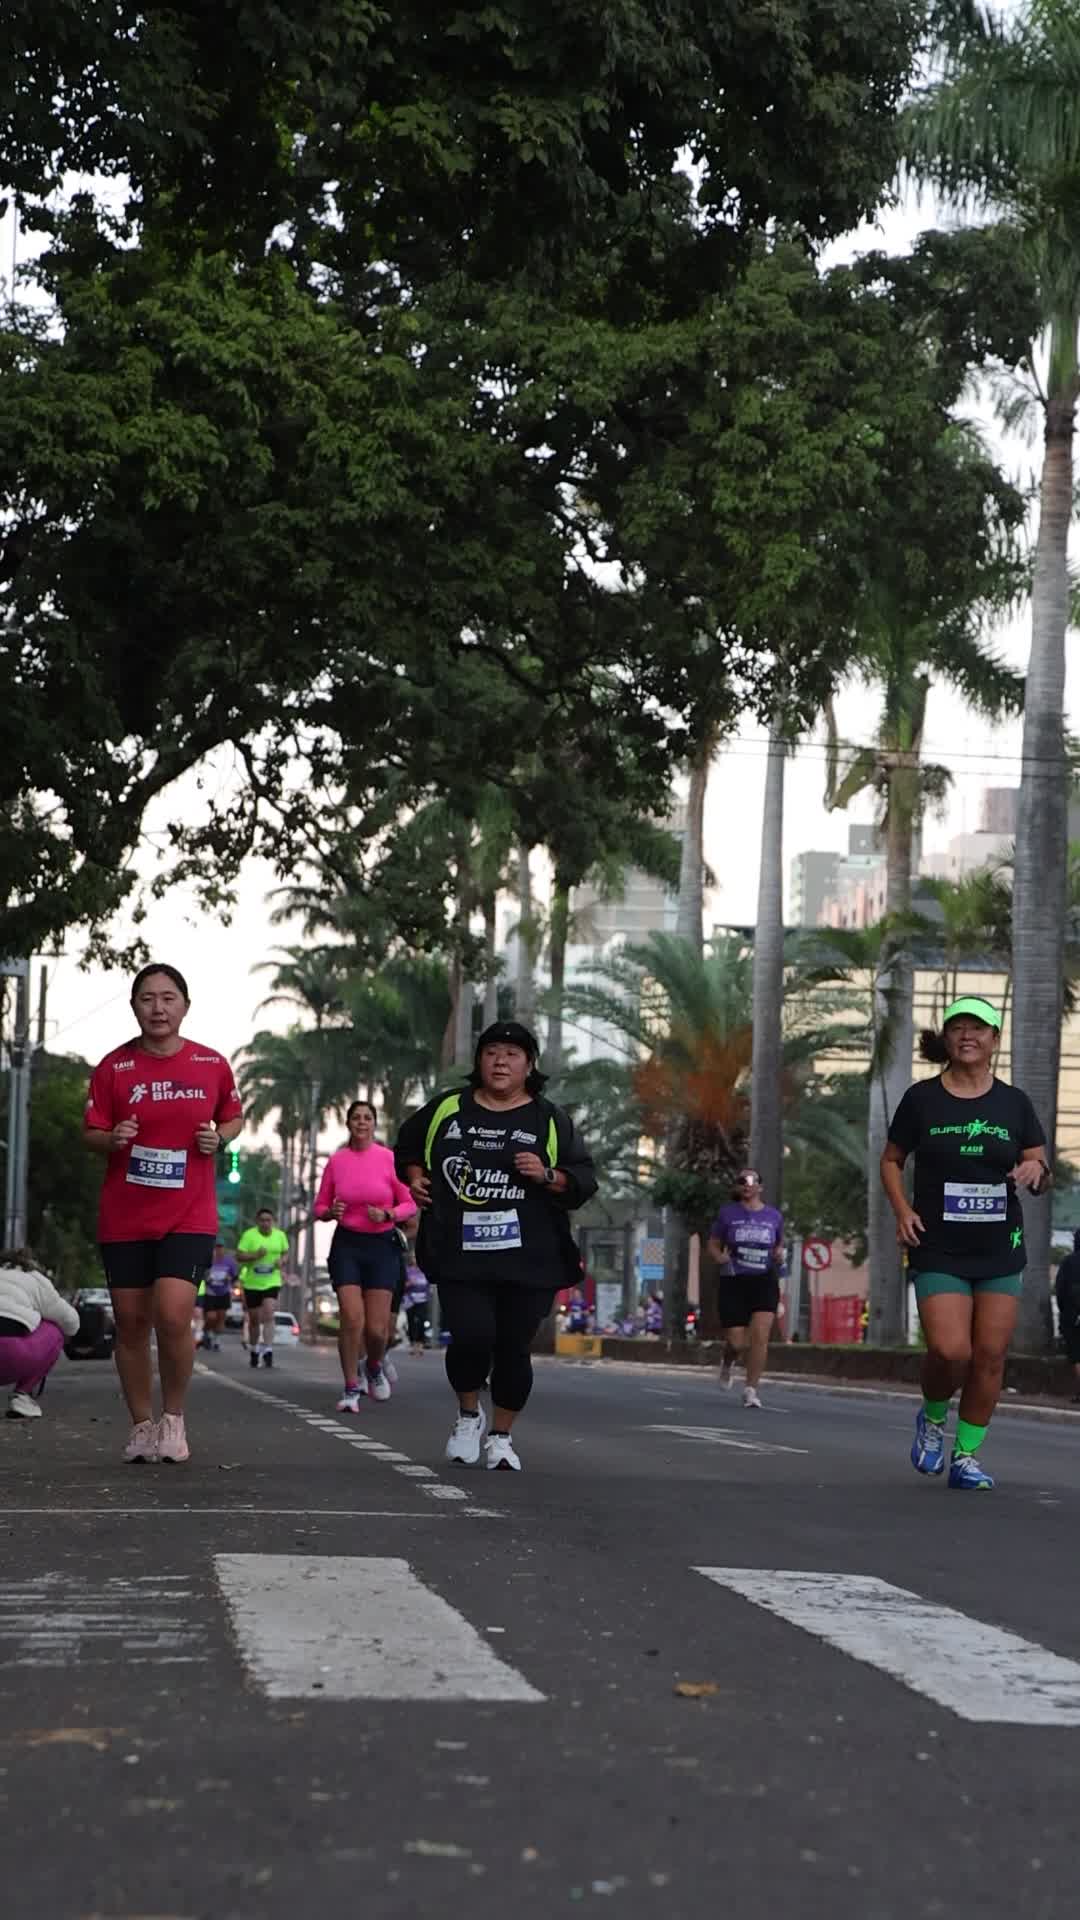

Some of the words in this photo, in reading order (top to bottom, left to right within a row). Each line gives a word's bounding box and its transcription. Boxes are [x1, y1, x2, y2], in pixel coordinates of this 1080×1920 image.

[151, 1081, 172, 1091] RP
[152, 1089, 206, 1101] BRASIL
[138, 1160, 174, 1175] 5558
[474, 1168, 510, 1184] Vida
[465, 1182, 526, 1200] Corrida
[957, 1197, 994, 1210] 6155
[473, 1225, 508, 1237] 5987
